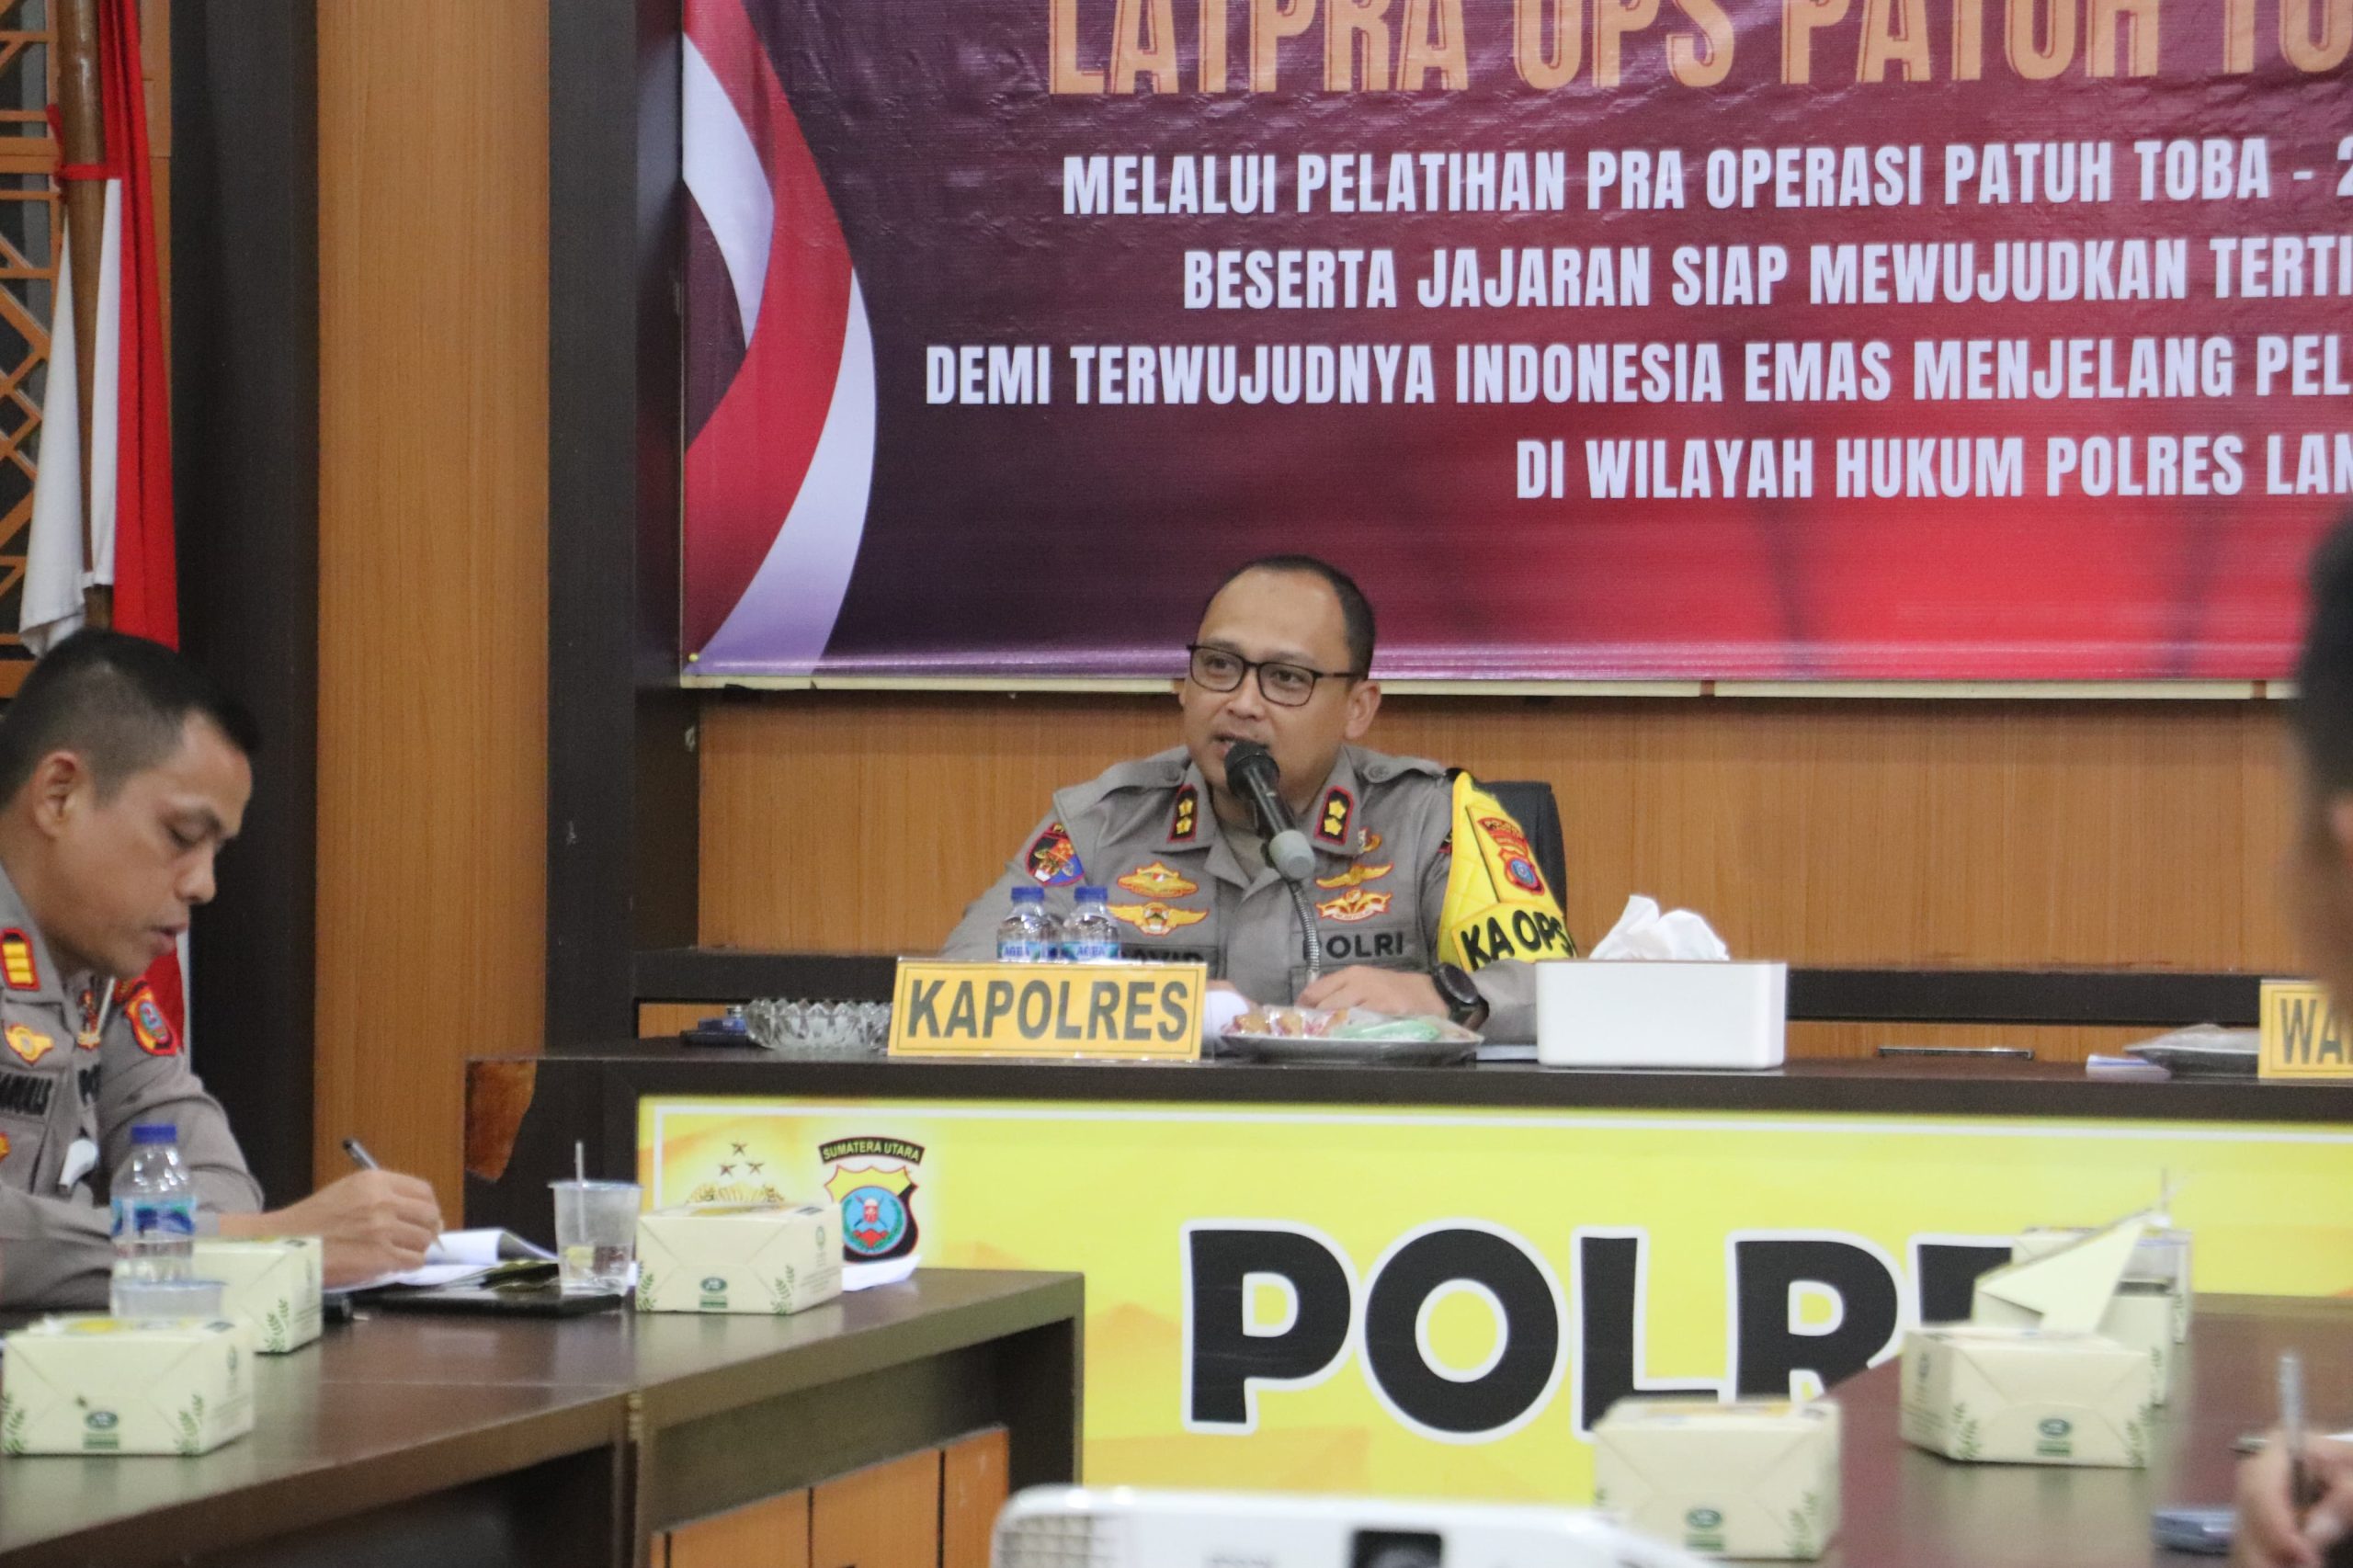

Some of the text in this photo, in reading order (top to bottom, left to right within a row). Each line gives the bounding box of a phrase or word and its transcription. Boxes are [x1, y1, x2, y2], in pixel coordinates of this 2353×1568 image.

[1063, 154, 1277, 215] MELALUI
[1296, 151, 1565, 213] PELATIHAN
[1586, 150, 1685, 210] PRA
[1706, 145, 1922, 210] OPERASI
[1945, 142, 2112, 205] PATUH
[2133, 138, 2270, 201] TOBA
[2293, 170, 2313, 180] -
[1184, 235, 2353, 310] BESERTA JAJARAN SIAP MEWUJUDKAN TERTI
[926, 335, 2350, 404] DEMI TERWUJUDNYA INDONESIA EMAS MENJELANG PEL
[1517, 440, 1563, 499] DI
[1586, 438, 1813, 499] WILAYAH
[1836, 437, 2023, 498] HUKUM
[2046, 435, 2244, 496] POLRES
[1460, 909, 1574, 971] KA OPS
[906, 978, 1188, 1042] KAPOLRES
[823, 1141, 919, 1161] SUMATERA UTARA
